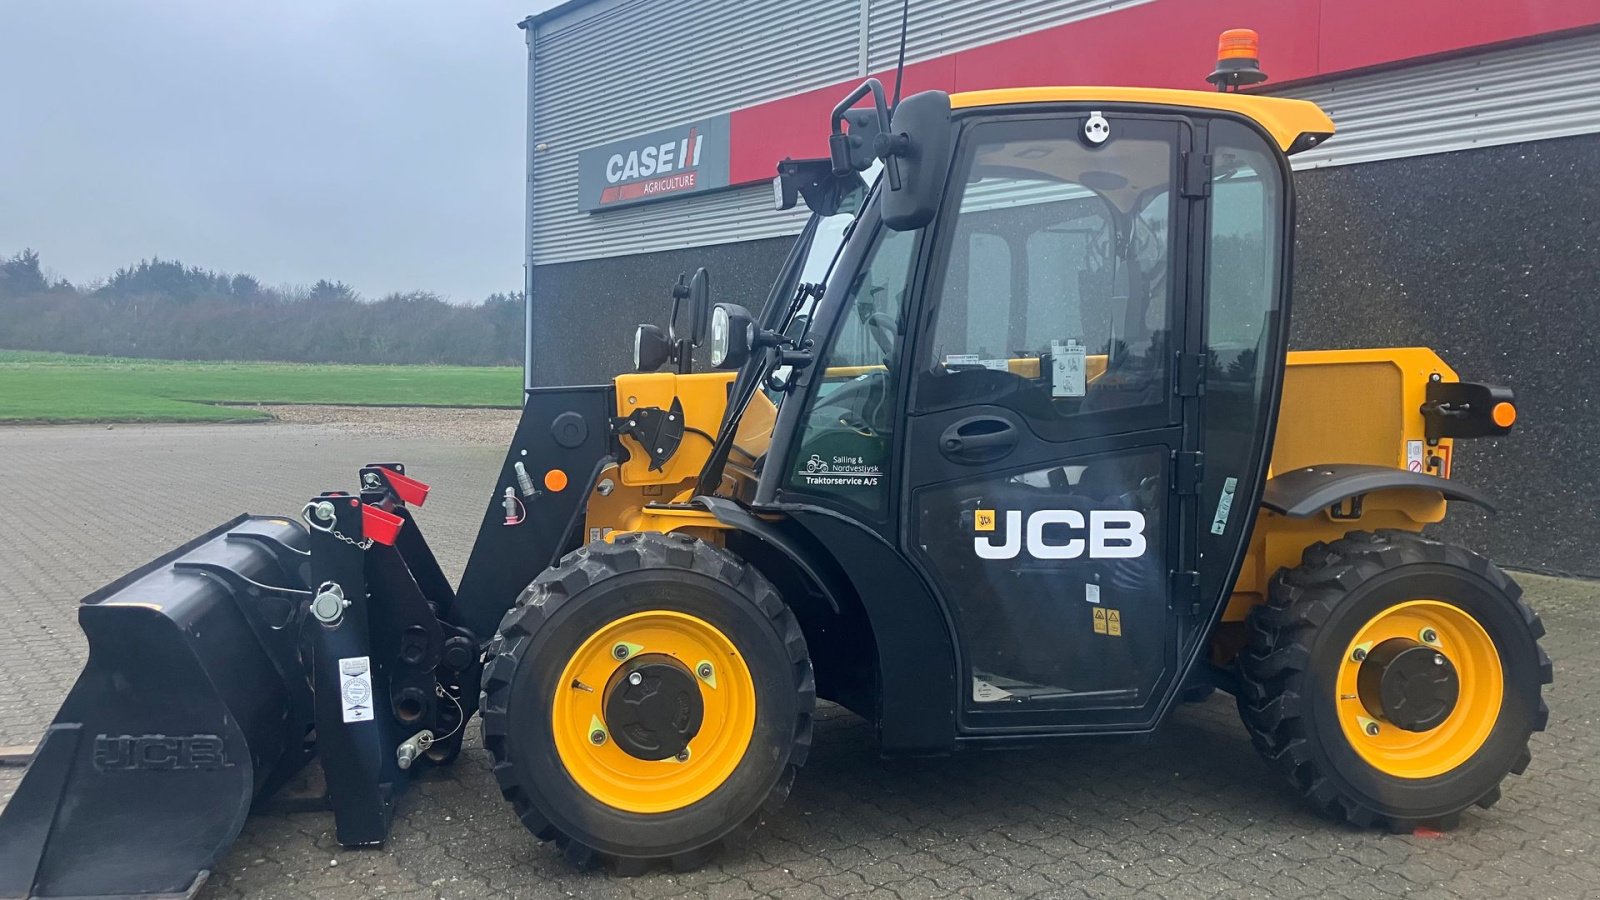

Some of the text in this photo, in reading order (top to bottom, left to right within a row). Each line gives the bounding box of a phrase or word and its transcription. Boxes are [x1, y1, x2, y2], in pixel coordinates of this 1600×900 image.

[606, 141, 676, 183] CASE
[643, 174, 694, 194] AGRICULTURE
[832, 465, 879, 473] Nordvestjysk
[858, 456, 863, 464] &
[806, 477, 878, 486] Traktorservice A/S
[974, 510, 1147, 559] JCB
[94, 734, 224, 769] JCB
